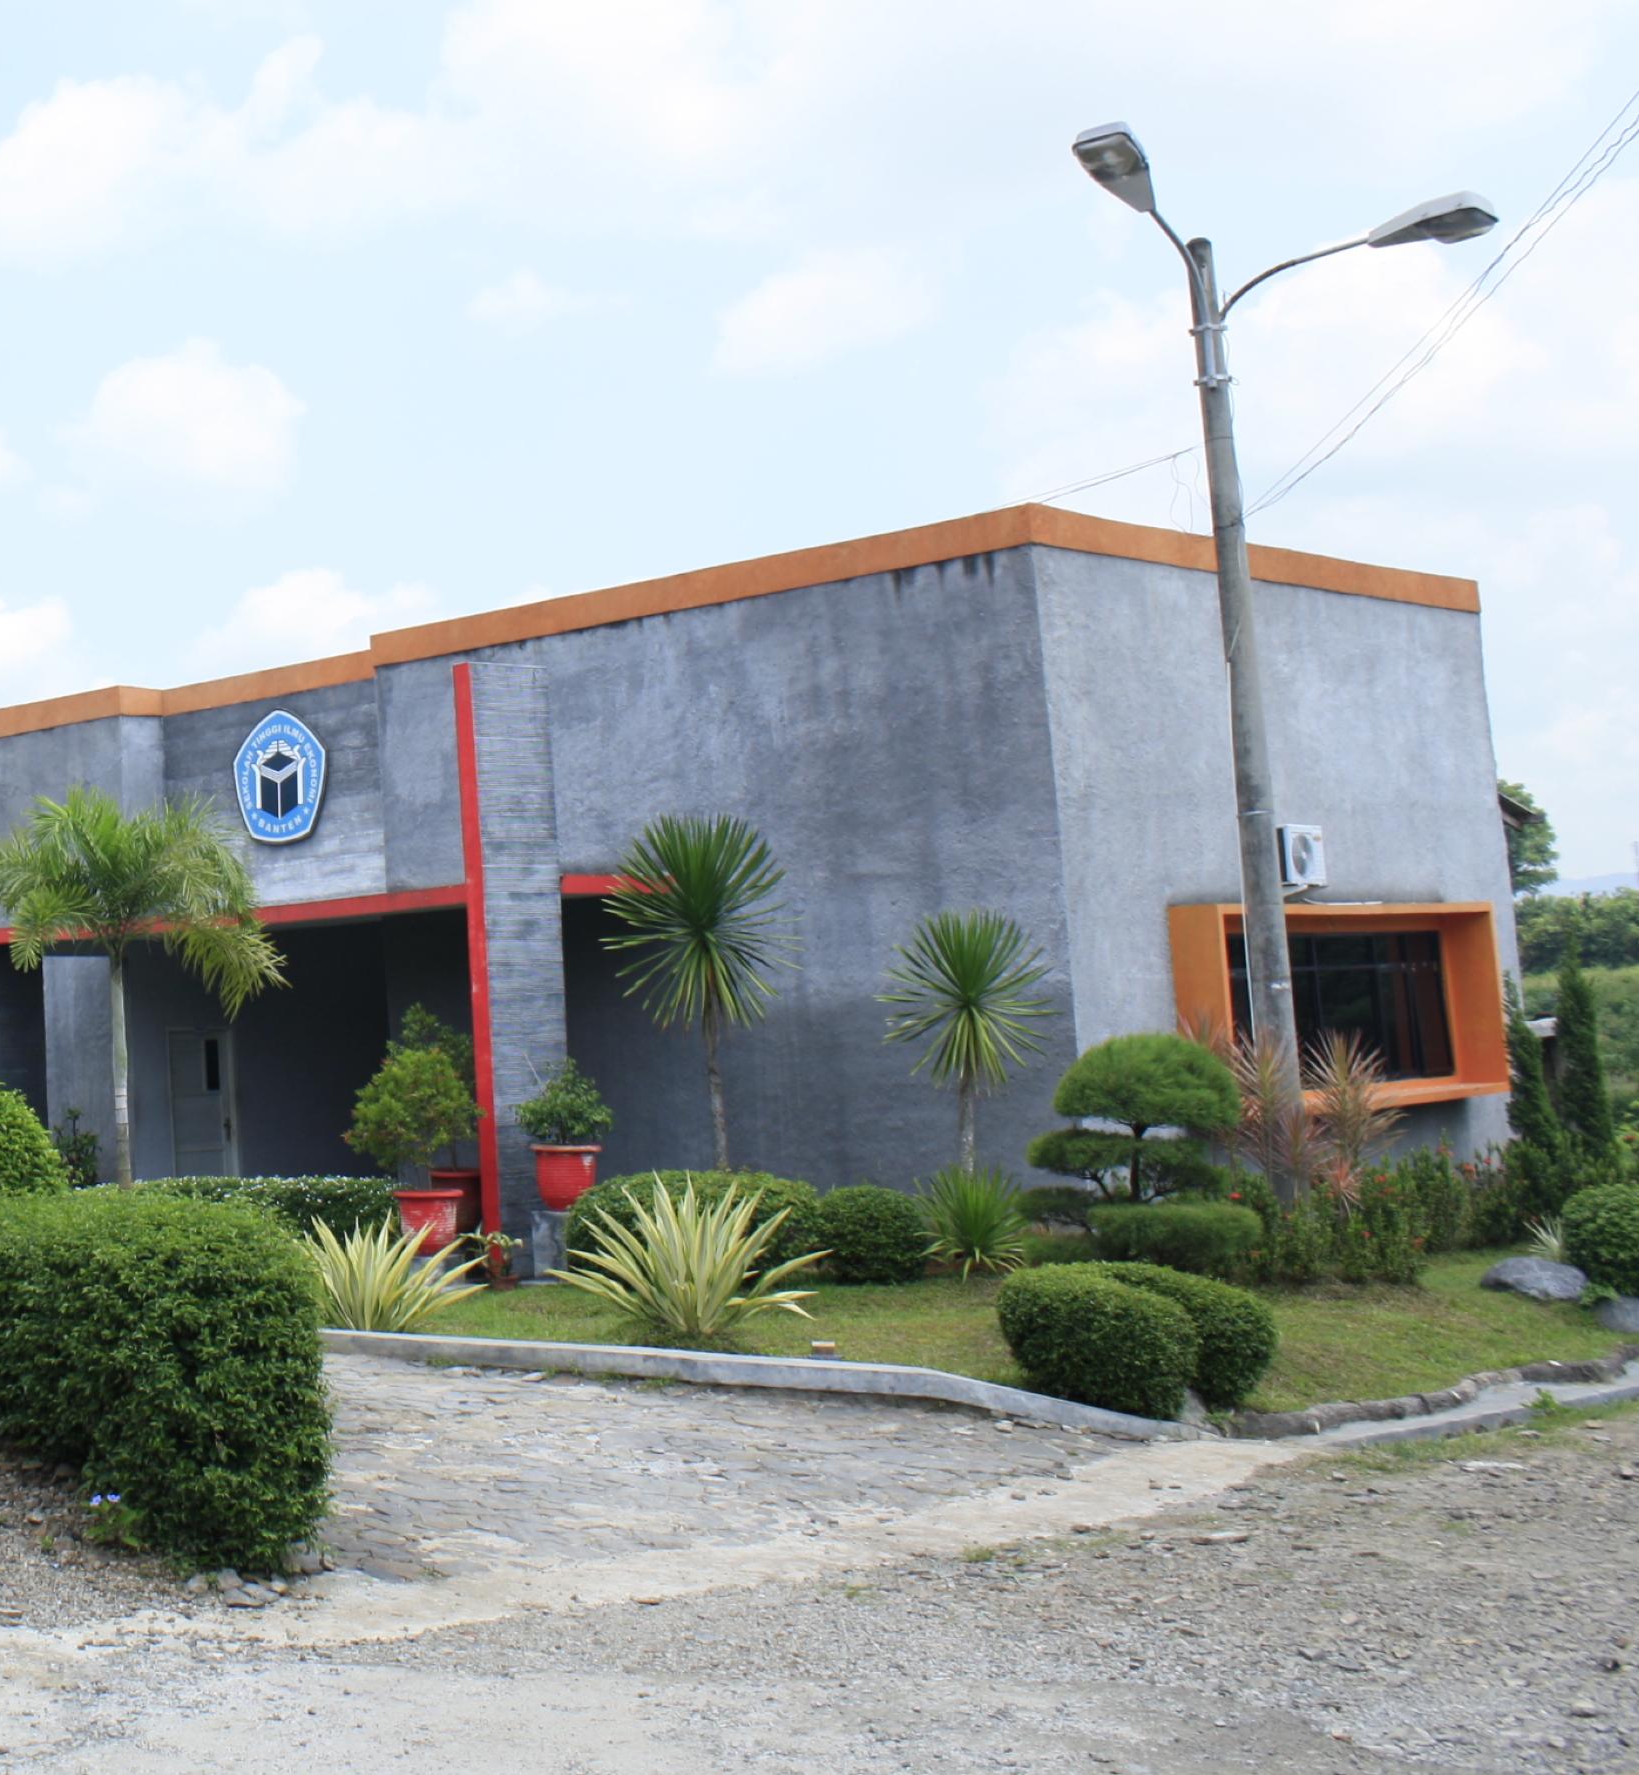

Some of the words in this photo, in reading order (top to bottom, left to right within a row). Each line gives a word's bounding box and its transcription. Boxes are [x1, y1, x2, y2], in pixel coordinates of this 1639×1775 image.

[241, 751, 255, 810] SEKOLAH
[251, 724, 282, 748] TINGGI
[283, 725, 306, 743] ILMU
[304, 743, 318, 804] EKONOMI
[257, 815, 303, 833] BANTEN
